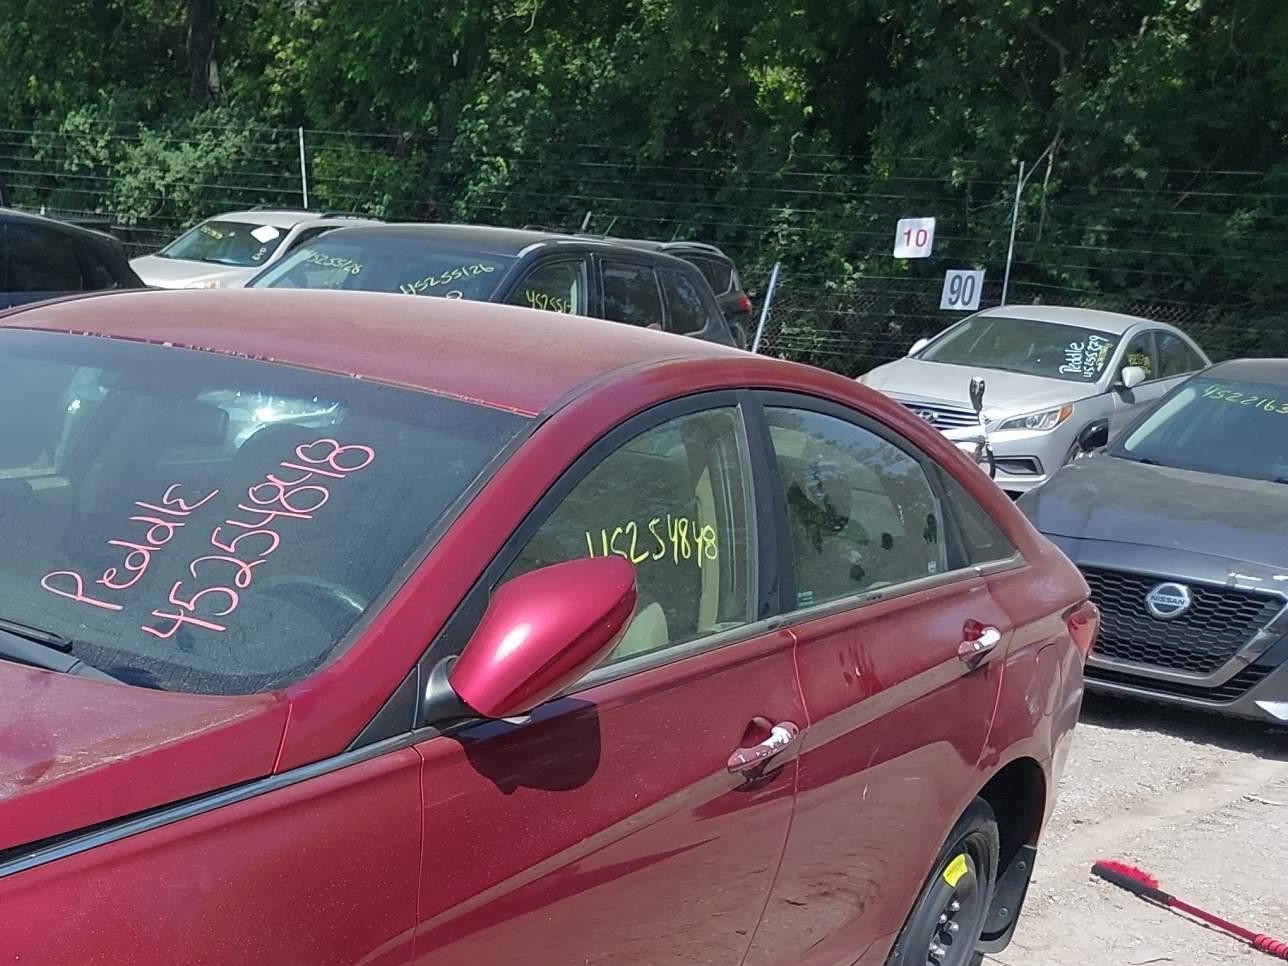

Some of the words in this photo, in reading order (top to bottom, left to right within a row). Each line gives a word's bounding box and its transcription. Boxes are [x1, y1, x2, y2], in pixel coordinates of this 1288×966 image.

[903, 228, 929, 248] 10
[948, 274, 976, 306] 90
[141, 438, 375, 639] 45254848
[1150, 595, 1186, 605] NISSAN
